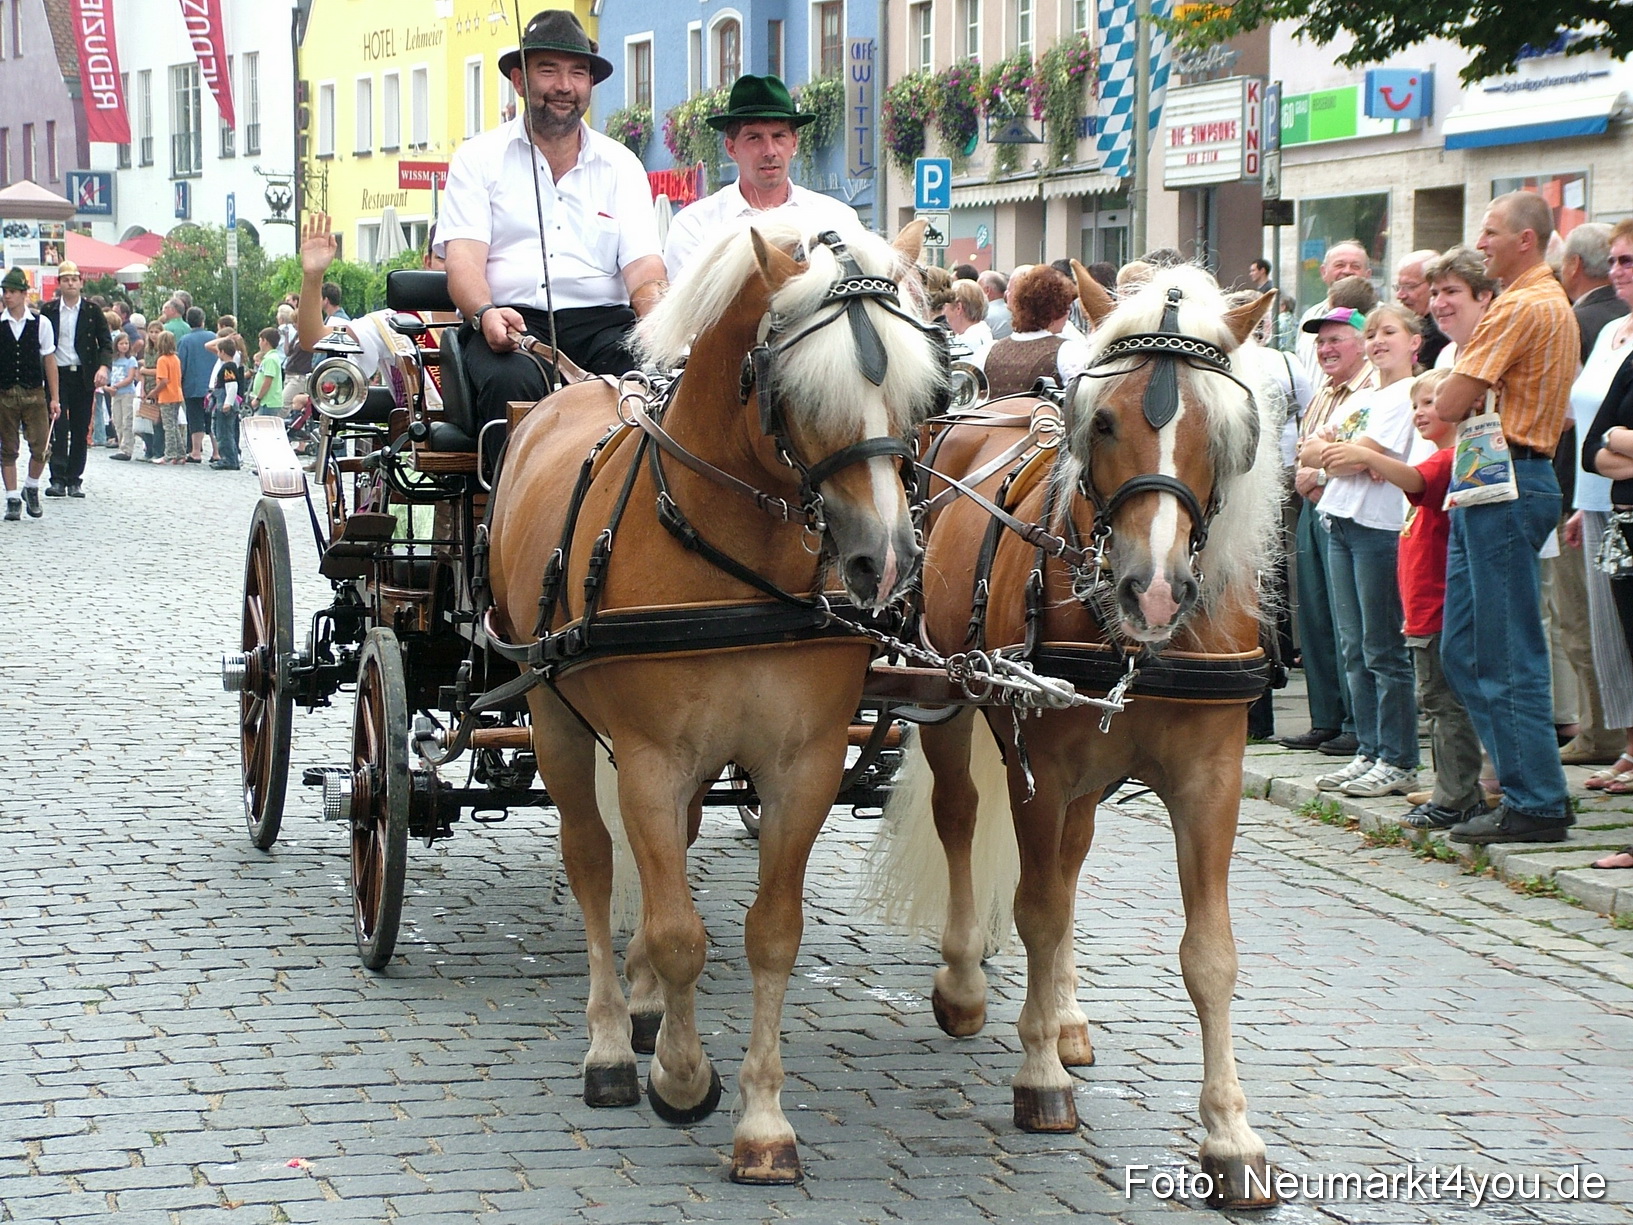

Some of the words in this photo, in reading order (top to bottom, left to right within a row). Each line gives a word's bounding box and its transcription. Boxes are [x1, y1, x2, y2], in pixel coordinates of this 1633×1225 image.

[363, 27, 396, 61] HOTEL
[406, 23, 443, 51] Lehmeier
[851, 40, 873, 60] CAFÉ
[852, 65, 871, 166] WITTL
[1171, 128, 1184, 147] DIE
[1191, 121, 1236, 144] SIMPSONS
[1247, 82, 1259, 174] KINO
[362, 188, 408, 210] Restaurant
[923, 164, 943, 204] P
